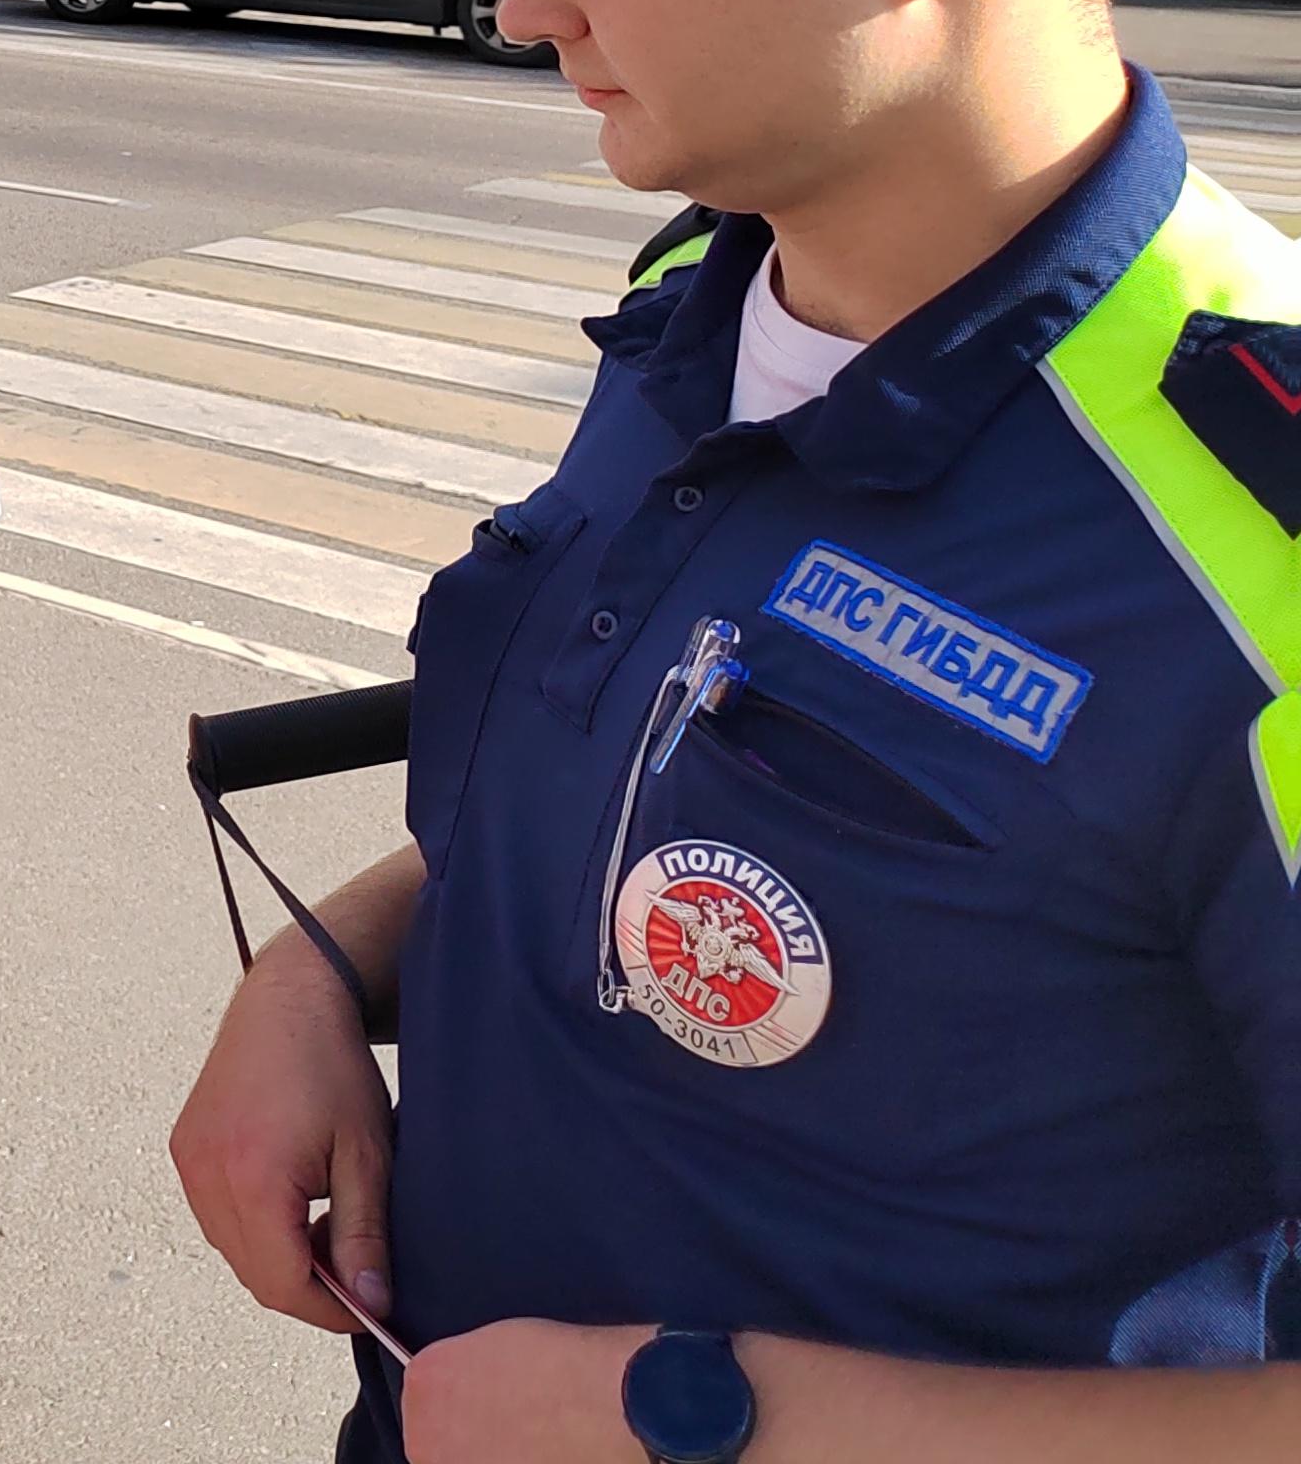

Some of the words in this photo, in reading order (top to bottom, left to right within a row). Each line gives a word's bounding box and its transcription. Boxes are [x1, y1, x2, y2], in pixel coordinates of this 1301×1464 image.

[785, 560, 885, 633] ДПС
[876, 602, 1059, 736] ГИБДД
[663, 848, 817, 957] ПОЛИЦИЯ
[637, 984, 736, 1060] 50-3041
[661, 963, 731, 1023] ДПС
